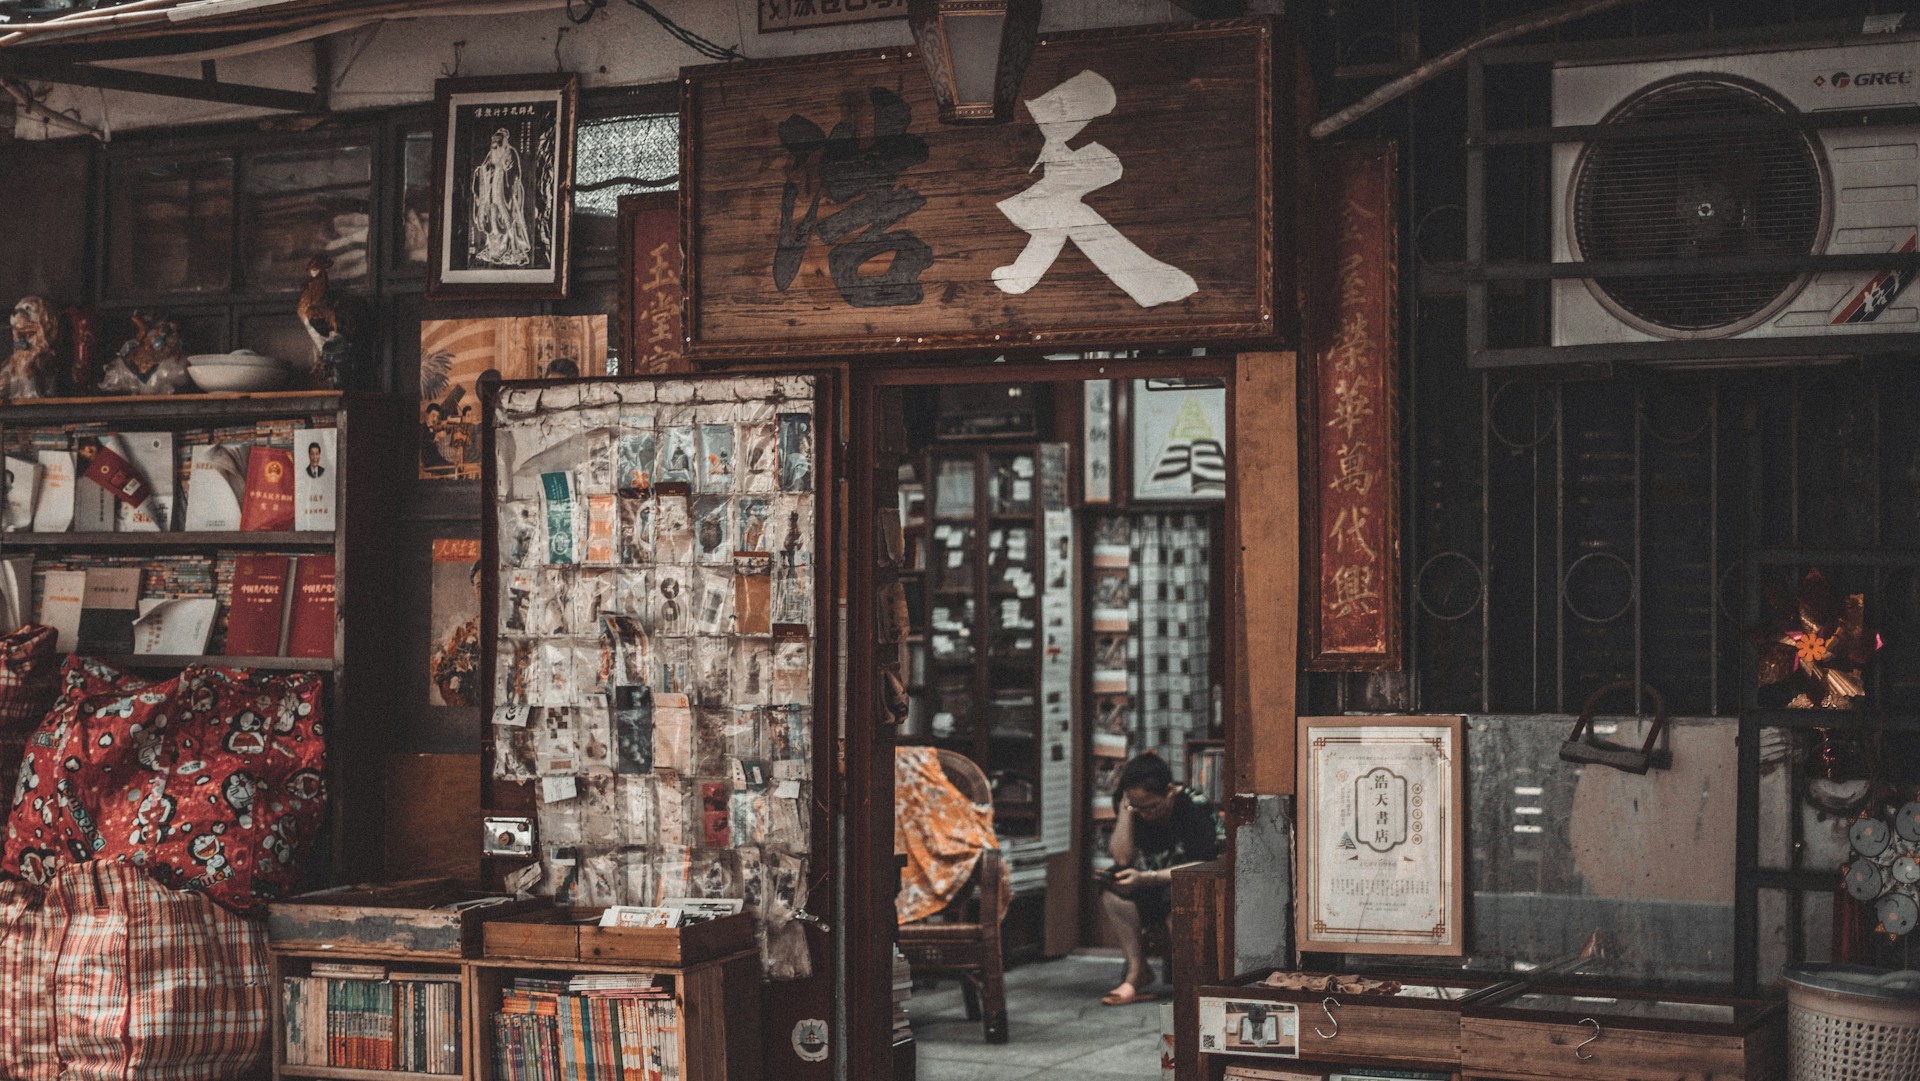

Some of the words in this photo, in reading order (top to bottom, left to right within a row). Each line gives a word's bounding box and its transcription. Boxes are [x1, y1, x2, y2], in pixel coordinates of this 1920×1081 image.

[1854, 71, 1912, 86] GREE
[1374, 774, 1389, 844] 浩天書店
